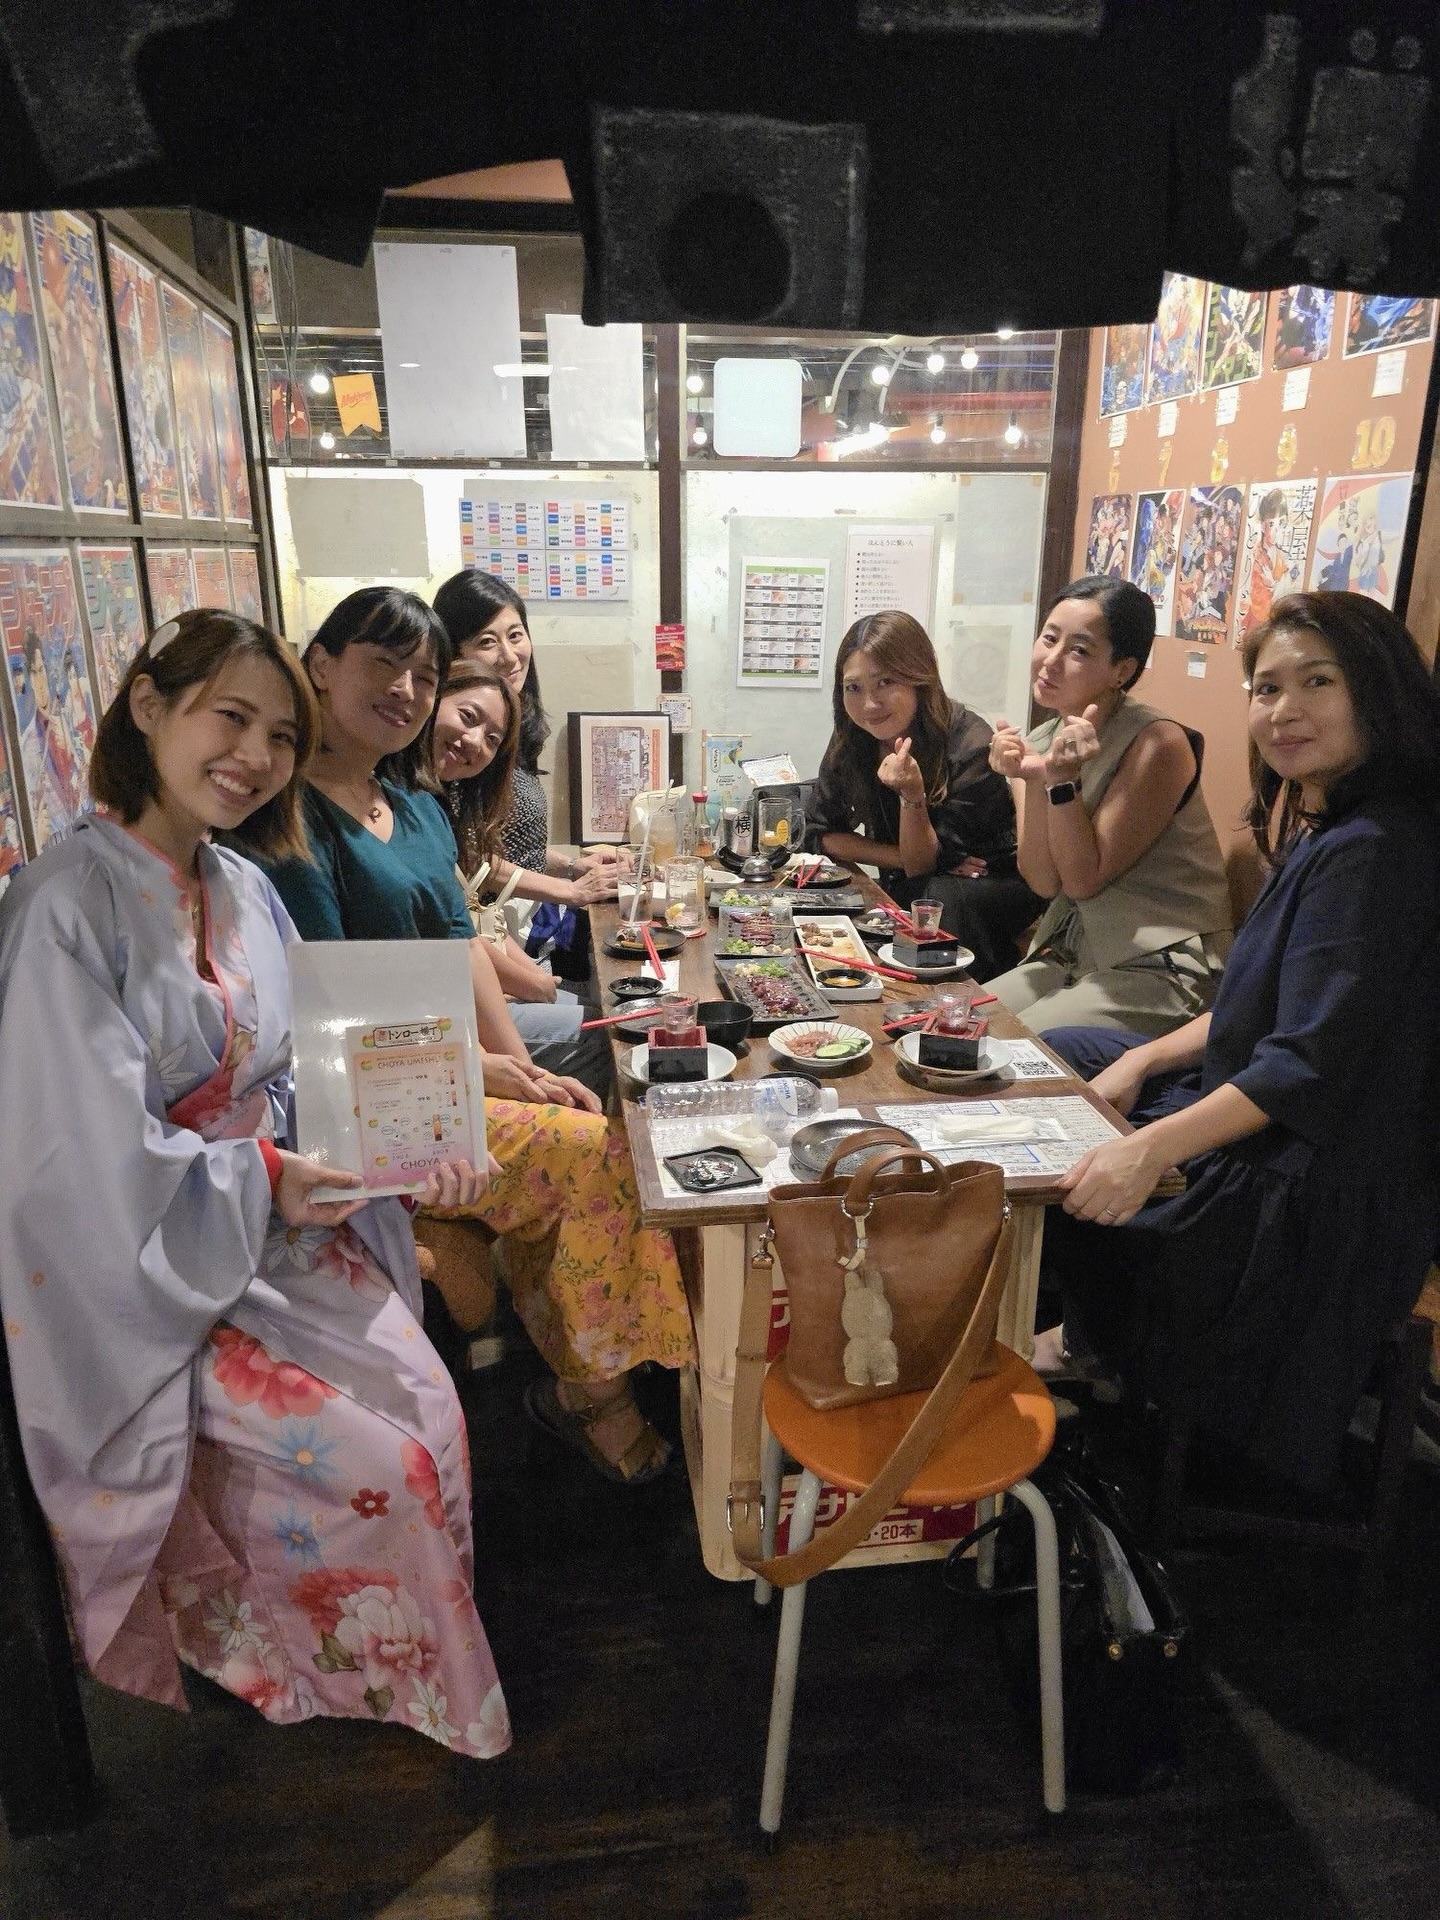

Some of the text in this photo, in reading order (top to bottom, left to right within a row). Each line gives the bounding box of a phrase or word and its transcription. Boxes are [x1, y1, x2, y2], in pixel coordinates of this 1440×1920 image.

[1352, 416, 1396, 469] 10
[735, 815, 751, 834] 横
[377, 1059, 406, 1070] CHOYA
[400, 1157, 441, 1171] CHOYA
